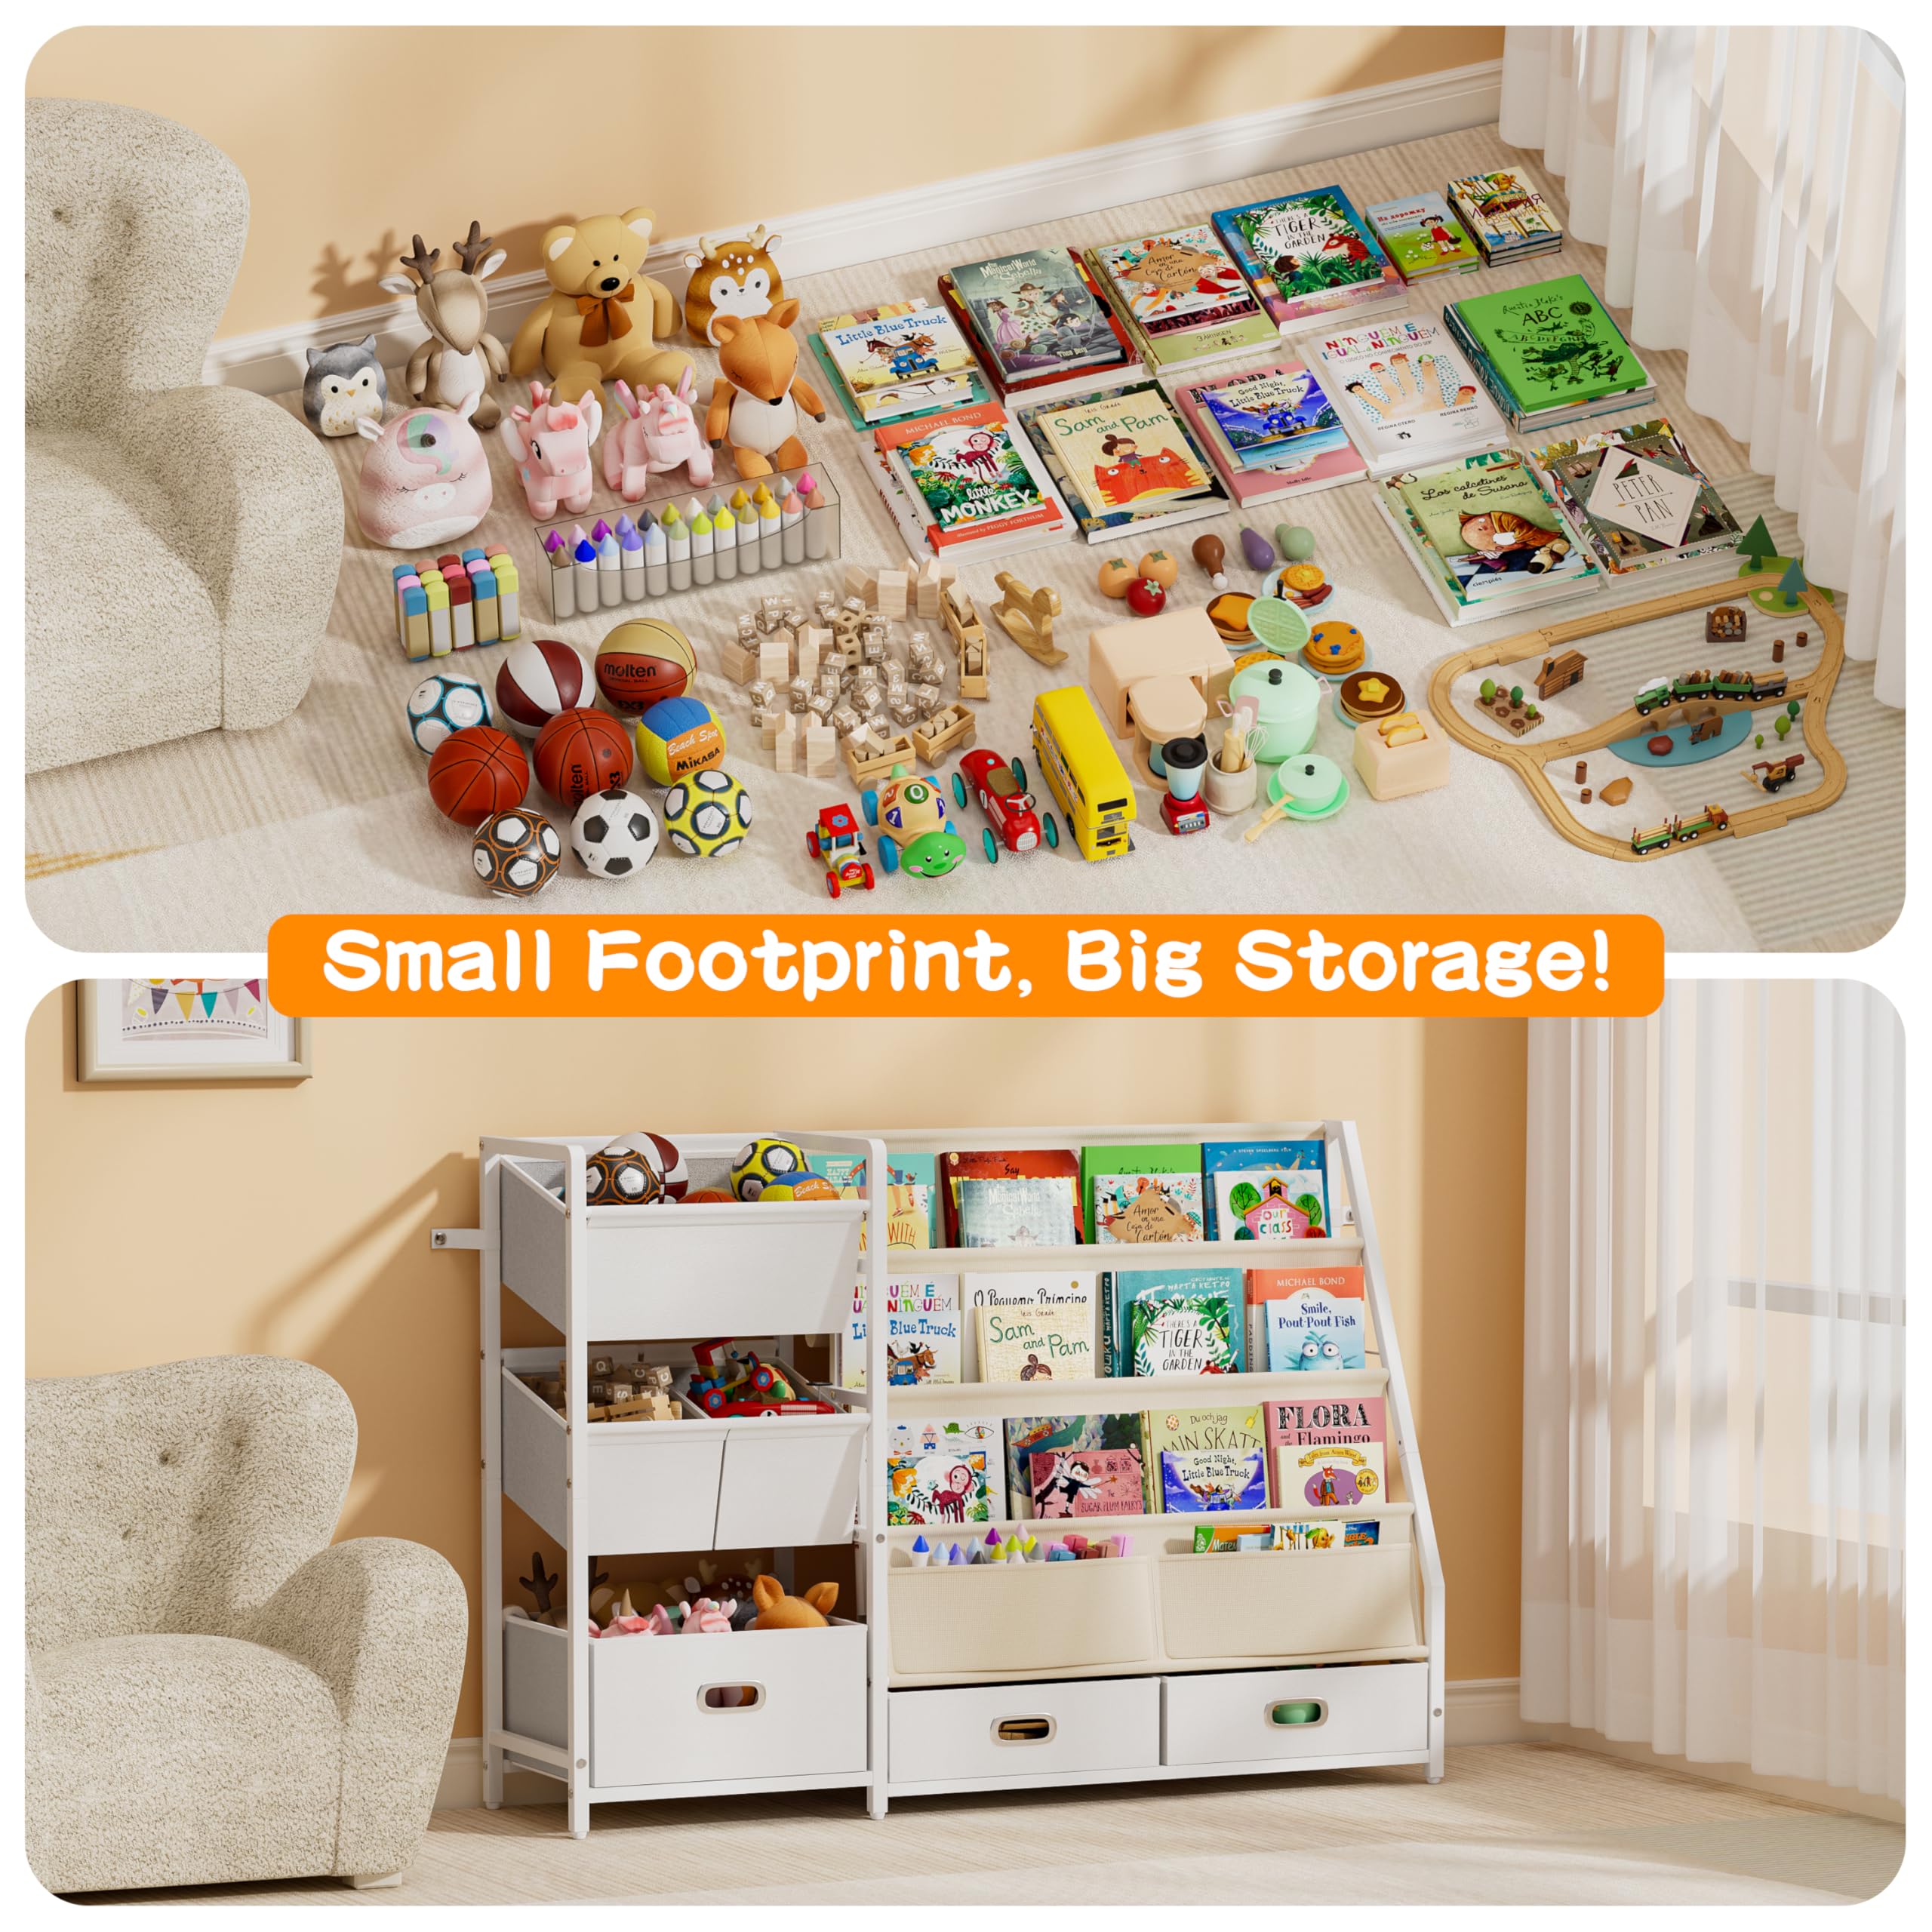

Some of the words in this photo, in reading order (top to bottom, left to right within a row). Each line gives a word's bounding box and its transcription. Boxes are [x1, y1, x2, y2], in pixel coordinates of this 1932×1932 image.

[1273, 217, 1321, 236] TIGER
[1297, 230, 1314, 238] THE
[1284, 233, 1325, 249] GARDEN
[1148, 254, 1174, 265] Amor
[980, 260, 1014, 278] Magical
[1012, 258, 1037, 272] World
[1522, 306, 1563, 326] ABC
[835, 330, 873, 346] Little
[874, 321, 904, 336] Blue
[904, 315, 948, 332] Truck
[1322, 345, 1361, 360] IGUAL
[1238, 383, 1260, 395] Good
[1260, 380, 1286, 392] Night,
[1229, 395, 1254, 408] Little
[1254, 390, 1275, 401] Blue
[1275, 384, 1304, 399] Truck
[906, 420, 949, 435] MICHAEL
[952, 411, 982, 424] BOND
[1054, 415, 1105, 436] Sam
[1097, 423, 1119, 434] and
[1120, 414, 1169, 433] Pam
[966, 485, 996, 501] little
[1421, 488, 1451, 501] Los
[1454, 474, 1508, 493] calcetines
[1463, 490, 1476, 500] de
[1478, 481, 1527, 497] Susana
[1612, 473, 1665, 502] PETER
[940, 488, 1030, 524] MONKEY
[1635, 498, 1675, 524] PAN
[986, 520, 1010, 531] PEGGY
[1010, 512, 1044, 526] FORTNUM
[604, 663, 656, 678] molten
[667, 734, 695, 756] Beach
[889, 811, 899, 825] 1
[1004, 1164, 1020, 1175] Say
[795, 1181, 820, 1198] Beach
[1133, 1206, 1159, 1217] Amor
[888, 1222, 916, 1244] WITH
[1143, 1222, 1154, 1231] de
[925, 1281, 934, 1297] É
[1168, 1282, 1196, 1292] МАРТА
[1198, 1281, 1230, 1289] КЕТРО
[1277, 1277, 1316, 1287] MICHAEL
[1319, 1276, 1346, 1286] BOND
[1300, 1302, 1332, 1315] Smile,
[889, 1320, 917, 1335] Blue
[918, 1318, 956, 1337] Truck
[1278, 1315, 1334, 1329] Pout-Pout
[1334, 1315, 1357, 1327] Fish
[990, 1316, 1035, 1343] Sam
[1023, 1337, 1045, 1349] and
[1048, 1334, 1090, 1358] Pam
[1159, 1328, 1203, 1349] TIGER
[1104, 1334, 1112, 1377] ОШКИ
[1169, 1349, 1175, 1358] IN
[1179, 1349, 1193, 1358] THE
[1162, 1358, 1202, 1371] GARDEN
[1190, 1415, 1200, 1424] Du
[1201, 1414, 1214, 1422] och
[1214, 1414, 1228, 1426] jag
[1276, 1403, 1371, 1432] FLORA
[1204, 1427, 1261, 1451] SKATT
[1297, 1431, 1371, 1446] Flamingo
[1193, 1456, 1213, 1466] Good
[1214, 1454, 1237, 1465] Night,
[1183, 1469, 1205, 1481] Little
[1206, 1465, 1225, 1477] Blue
[1225, 1468, 1250, 1479] Truck
[1081, 1502, 1102, 1512] SUGAR
